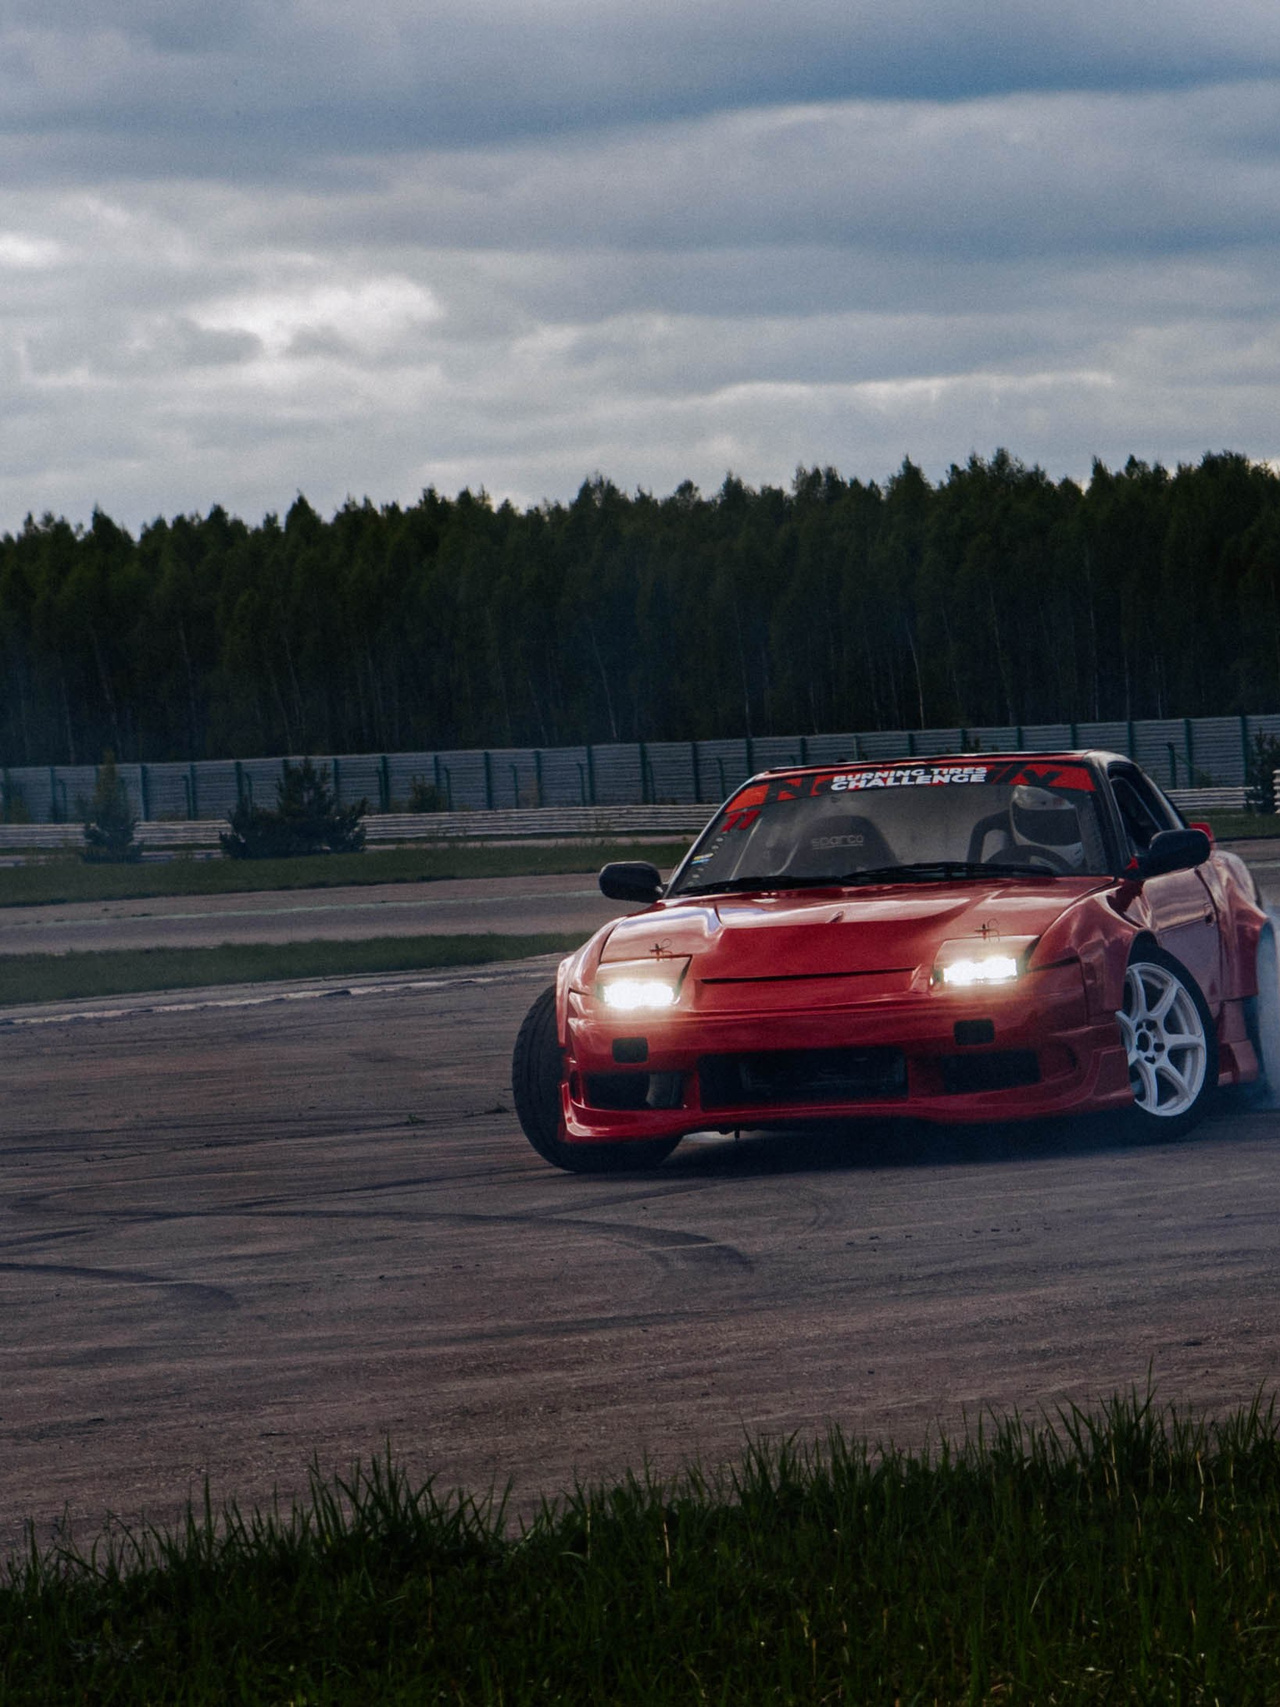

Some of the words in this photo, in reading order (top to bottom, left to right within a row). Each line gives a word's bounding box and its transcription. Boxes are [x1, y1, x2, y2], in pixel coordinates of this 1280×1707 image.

[830, 773, 986, 791] CHALLENGE
[832, 768, 925, 783] BURNING
[931, 766, 988, 776] TIRES
[811, 834, 864, 850] sparco
